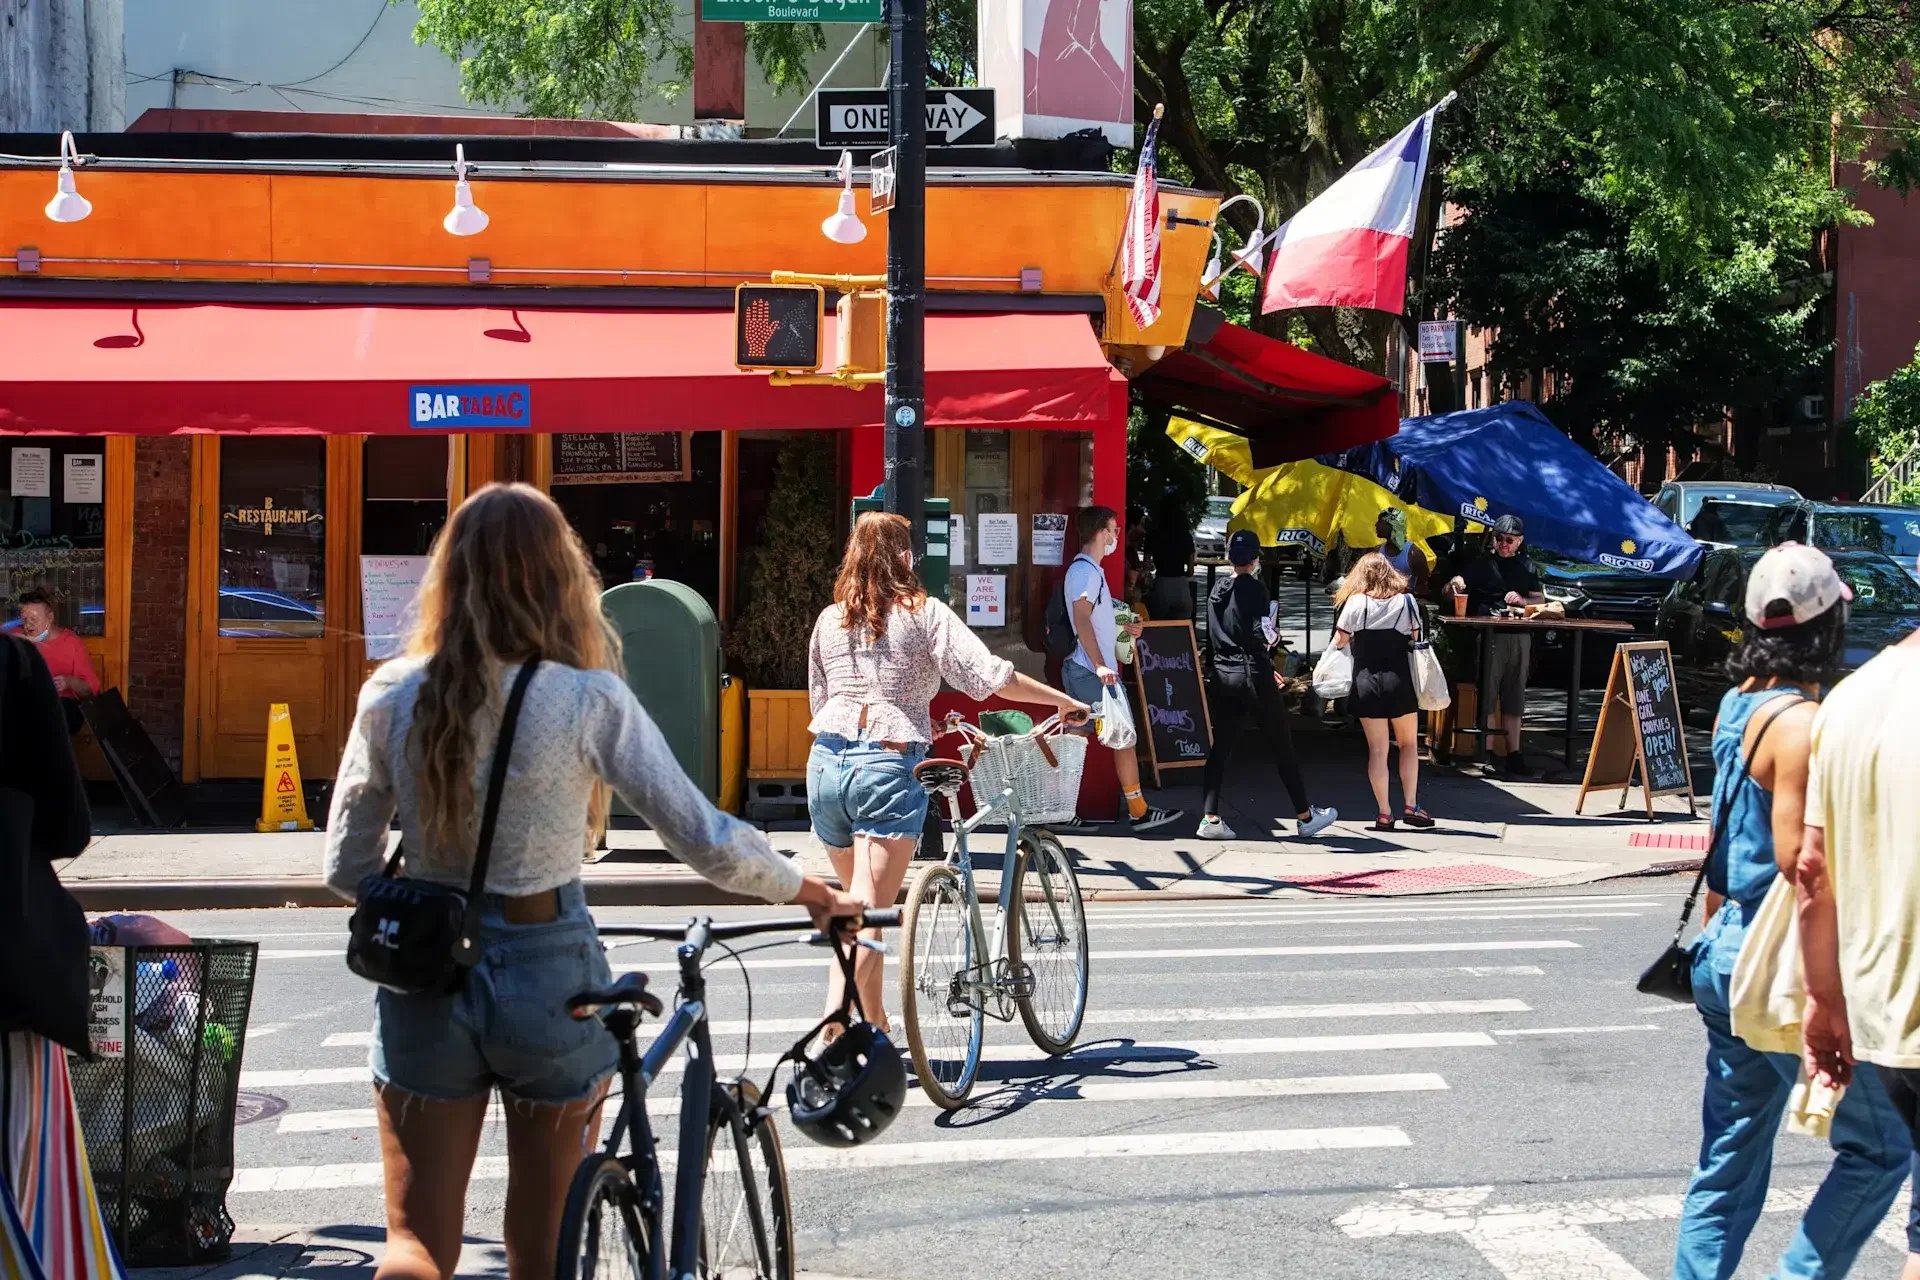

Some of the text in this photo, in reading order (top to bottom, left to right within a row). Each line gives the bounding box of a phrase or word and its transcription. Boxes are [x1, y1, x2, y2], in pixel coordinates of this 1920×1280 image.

[768, 6, 819, 18] Boulevard
[844, 107, 889, 129] ONE
[1421, 324, 1455, 333] NO PARKING
[561, 433, 596, 441] STELLA
[578, 441, 607, 451] LAGER
[238, 509, 309, 523] RESTAURANT
[1603, 555, 1650, 570] RICARD
[977, 576, 993, 584] WE
[975, 585, 995, 593] ARE
[971, 594, 998, 602] OPEN
[1635, 688, 1652, 704] ONE
[1638, 706, 1655, 720] GIRL
[1641, 717, 1671, 735] COOKIES
[1645, 727, 1676, 757] OPEN!
[97, 1041, 123, 1053] FINE
